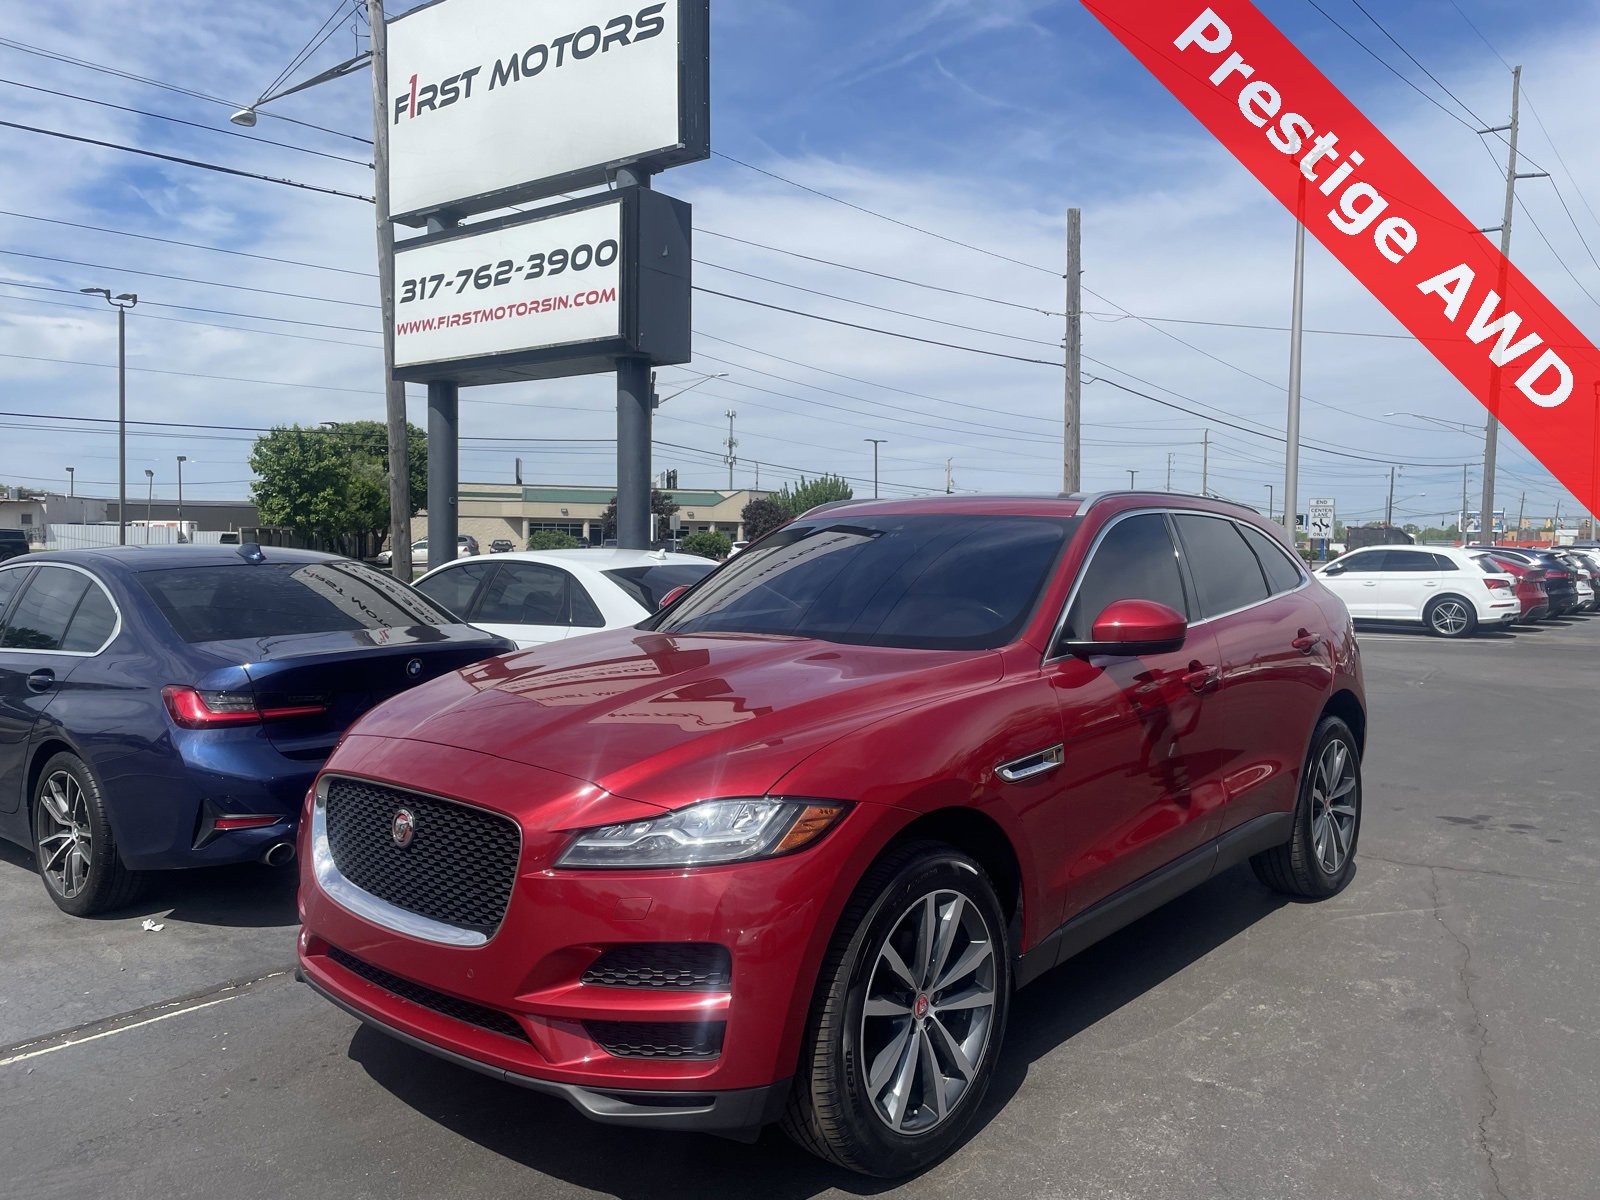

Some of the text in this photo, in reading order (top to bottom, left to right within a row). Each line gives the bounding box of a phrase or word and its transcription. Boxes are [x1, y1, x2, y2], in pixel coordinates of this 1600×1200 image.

[488, 2, 667, 91] MOTORS
[399, 239, 619, 304] 317-762-3900
[396, 288, 617, 336] WWW.FIRSTMOTORSIN.COM
